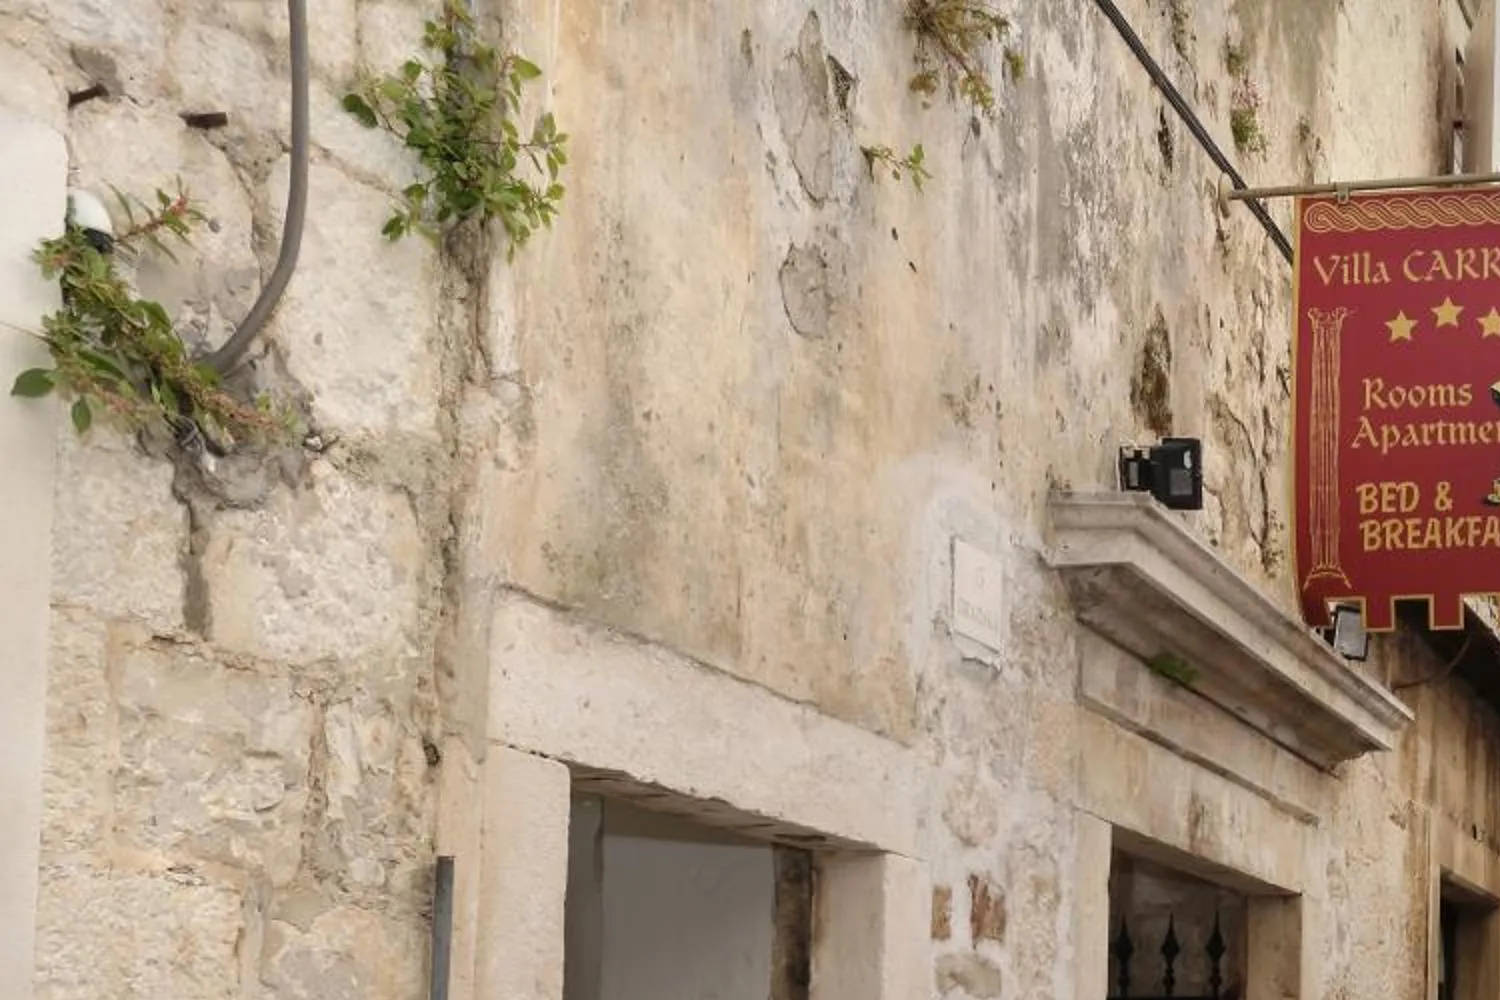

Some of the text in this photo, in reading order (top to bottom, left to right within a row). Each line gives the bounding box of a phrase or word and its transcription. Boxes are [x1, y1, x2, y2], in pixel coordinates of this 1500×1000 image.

[1313, 253, 1391, 285] Villa
[1361, 377, 1474, 410] Rooms
[1356, 481, 1454, 515] BED &
